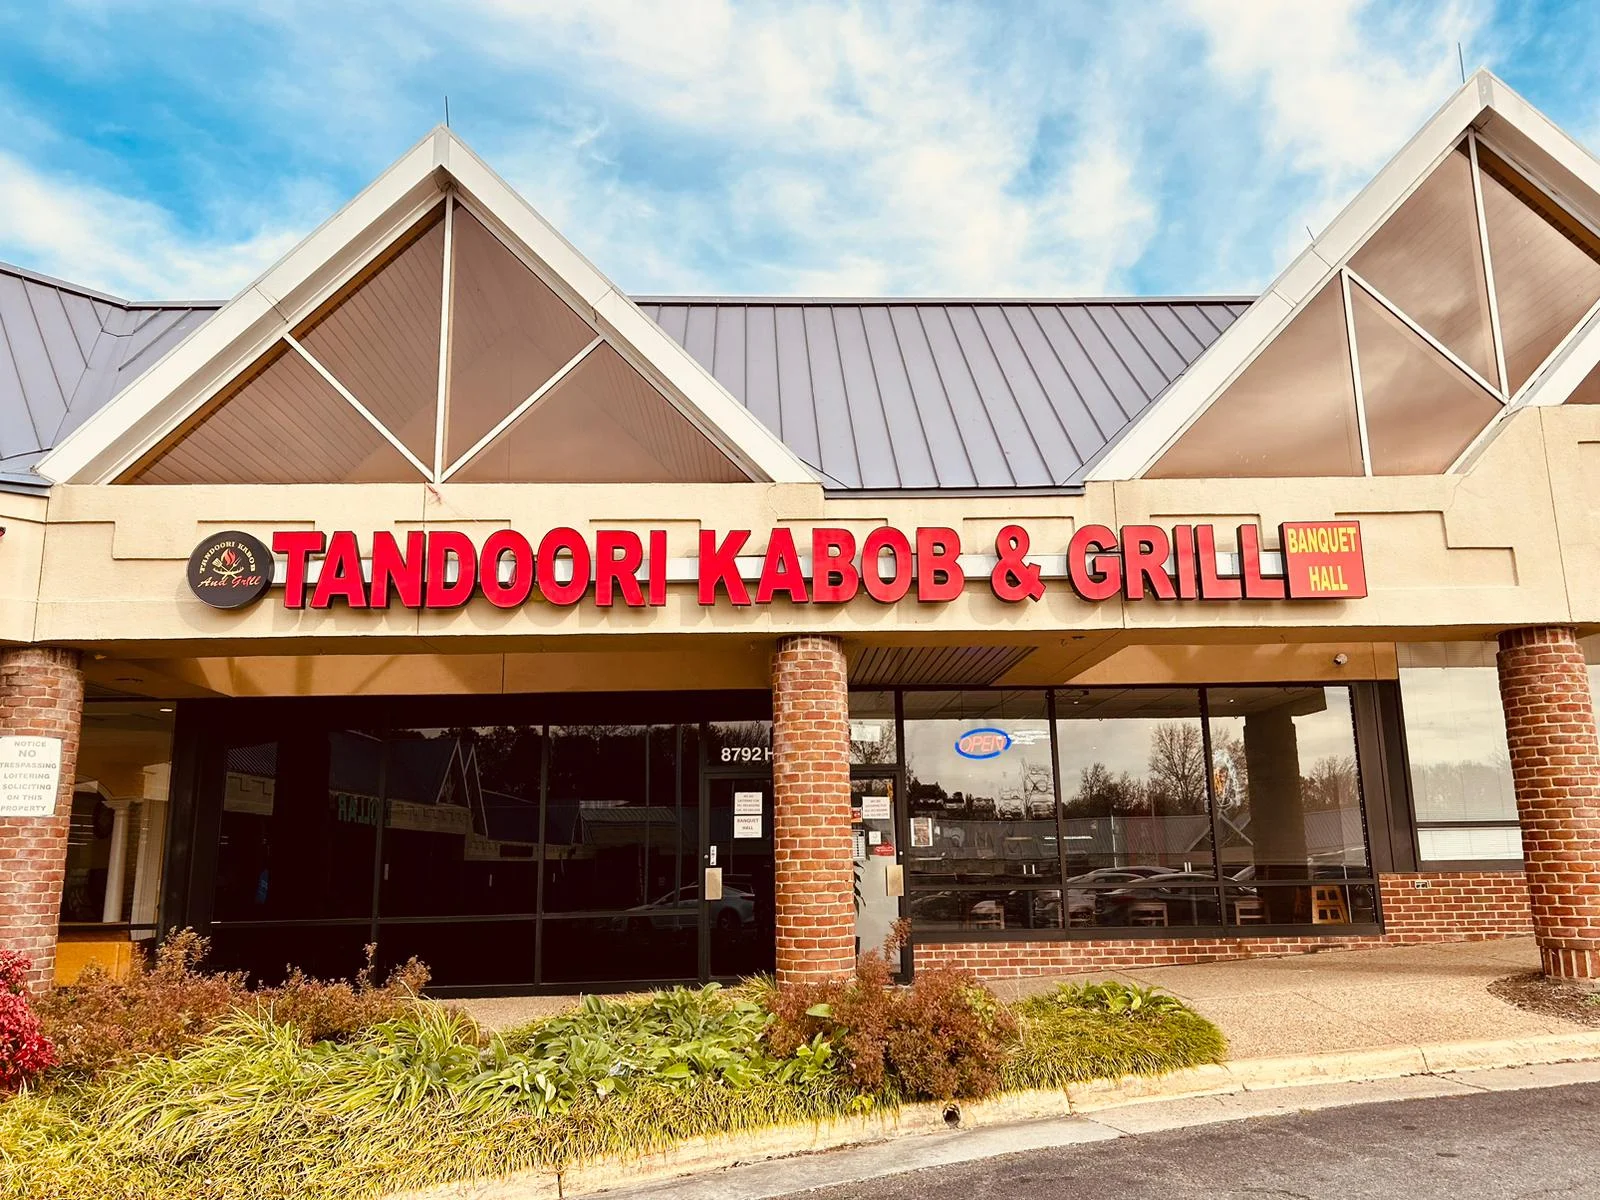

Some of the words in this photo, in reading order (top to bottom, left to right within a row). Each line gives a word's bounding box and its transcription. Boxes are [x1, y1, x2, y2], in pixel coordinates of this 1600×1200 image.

[1287, 527, 1356, 554] BANQUET
[199, 541, 235, 574] TANDOORI
[237, 543, 256, 572] KABOB
[272, 526, 667, 609] TANDOORI
[697, 525, 965, 605] KABOB
[991, 525, 1046, 602] &
[1067, 524, 1285, 600] GRILL
[197, 576, 228, 588] And
[231, 575, 262, 588] Grill
[1308, 565, 1348, 592] HALL
[960, 735, 1005, 752] OPEN
